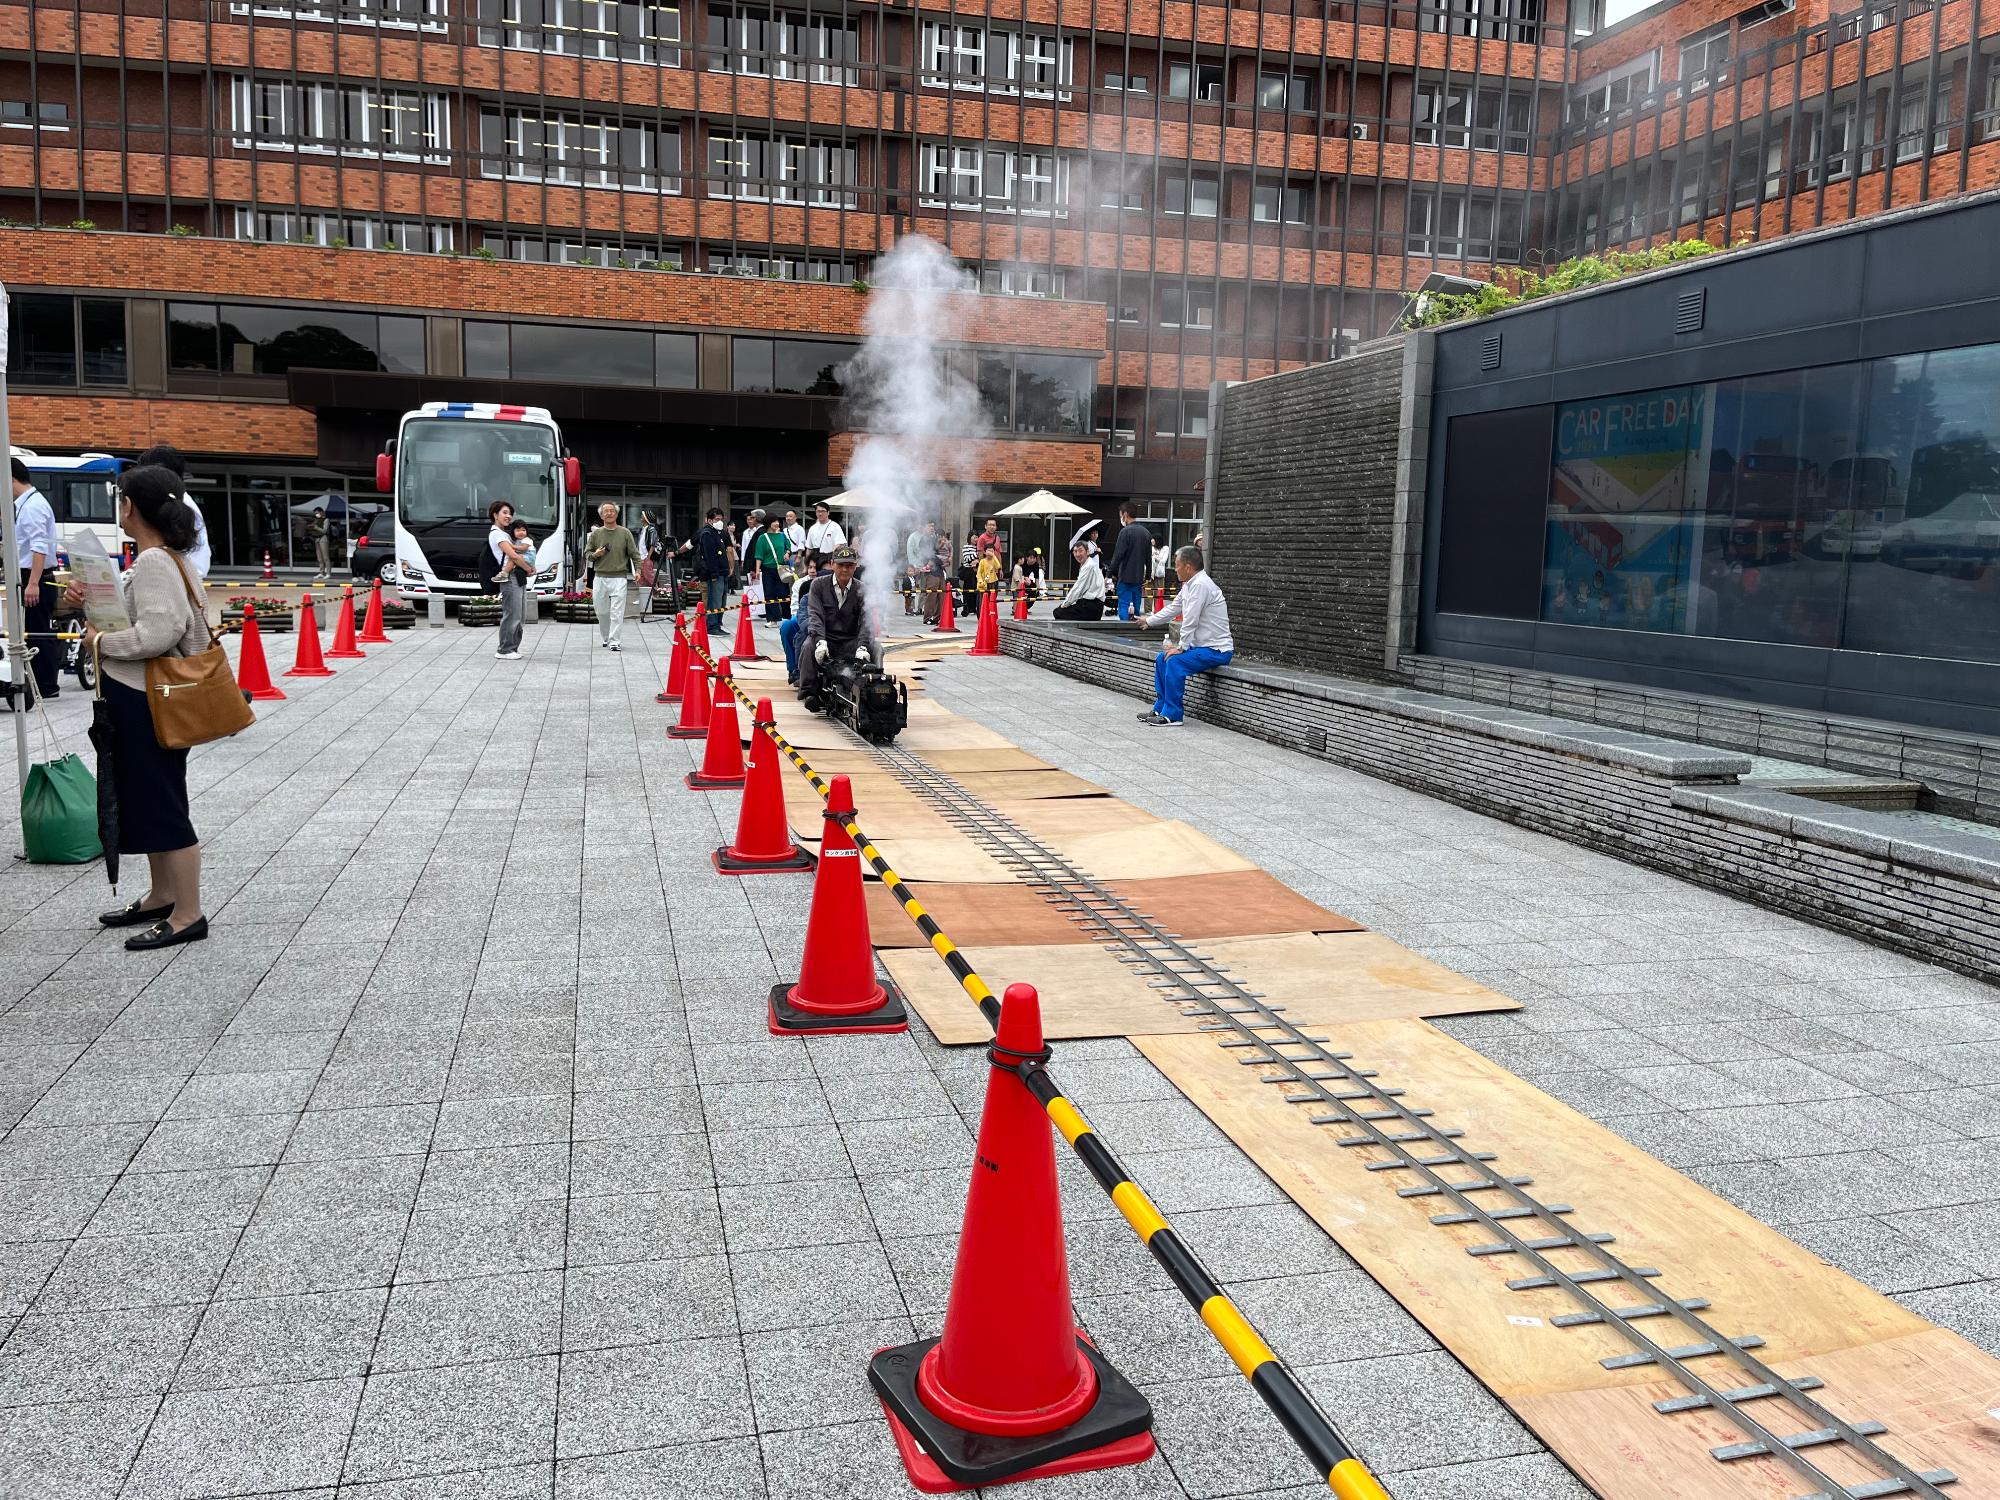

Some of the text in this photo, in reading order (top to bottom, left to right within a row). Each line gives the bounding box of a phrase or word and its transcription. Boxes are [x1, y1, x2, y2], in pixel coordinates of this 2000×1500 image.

[1558, 393, 1705, 455] CAR FREE DAY
